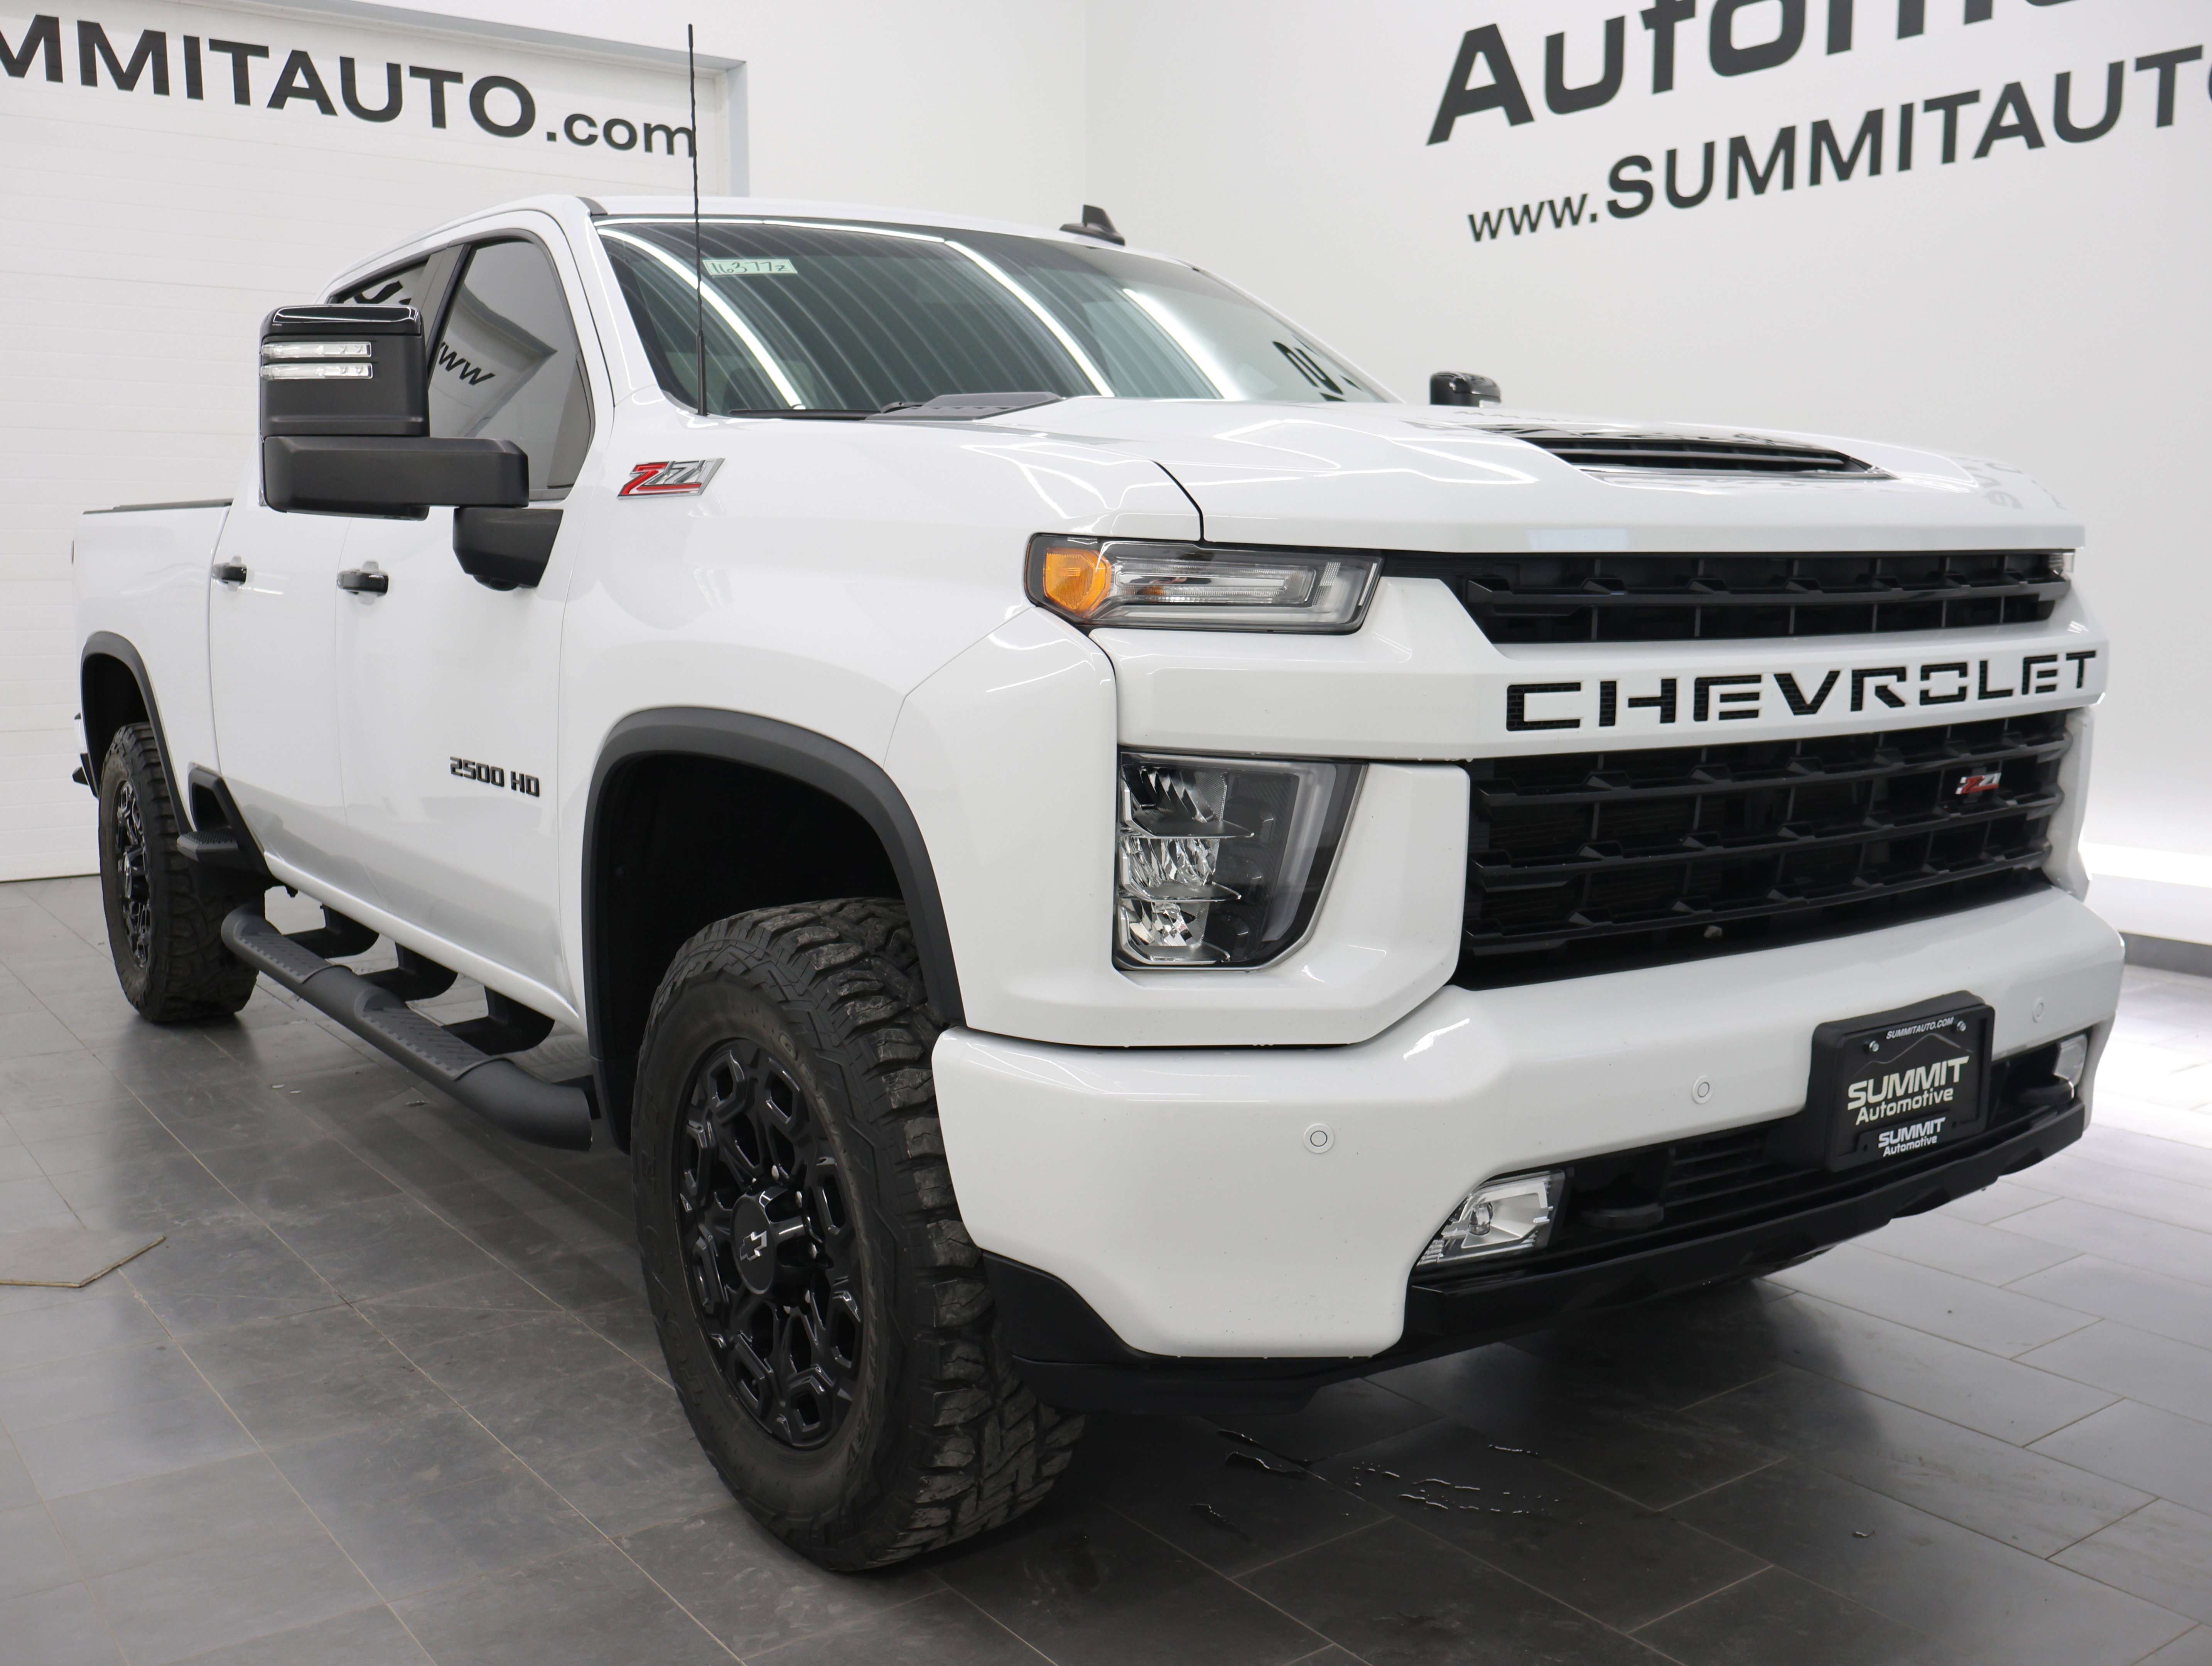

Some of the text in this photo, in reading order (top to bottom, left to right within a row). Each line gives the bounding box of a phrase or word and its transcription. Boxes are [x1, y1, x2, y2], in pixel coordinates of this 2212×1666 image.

[1468, 45, 2212, 242] www.SUMMITAUT
[617, 457, 725, 500] Z71
[1506, 651, 2096, 732] CHEVROLET
[450, 756, 540, 798] 2500 HD
[1886, 1017, 1954, 1040] SUMMITAUTO.COM
[1847, 1056, 1970, 1111] SUMMIT
[1855, 1087, 1954, 1126] Automotive
[1878, 1116, 1946, 1148] SUMMIT
[1882, 1135, 1938, 1157] Automotive
